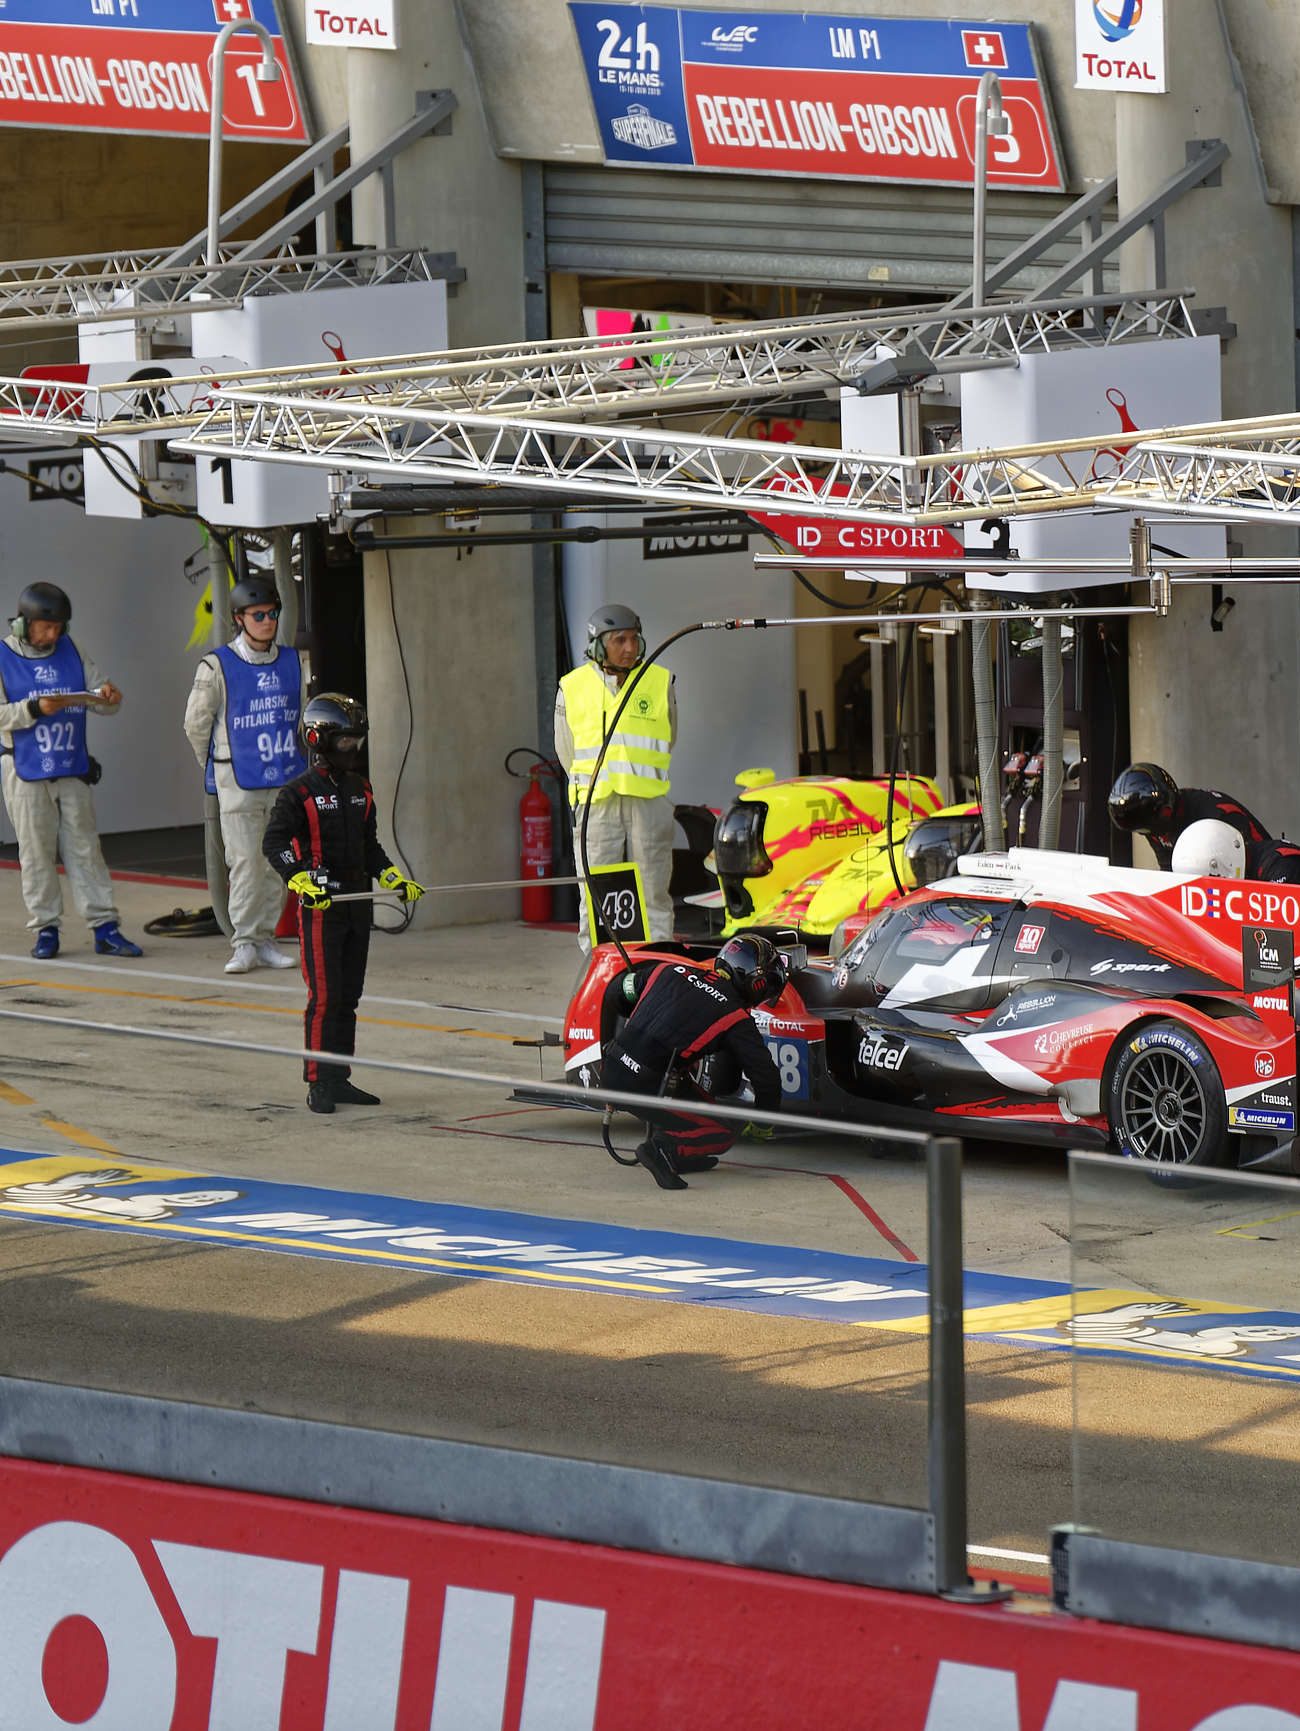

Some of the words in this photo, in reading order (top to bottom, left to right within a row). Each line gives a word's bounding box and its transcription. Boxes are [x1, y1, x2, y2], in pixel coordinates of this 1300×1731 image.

[314, 9, 388, 37] TOTAL
[596, 19, 660, 72] 24h
[829, 27, 855, 58] LM
[860, 30, 881, 60] P1
[599, 69, 617, 84] LE
[618, 71, 660, 87] MANS
[1082, 53, 1156, 81] TOTAL
[235, 64, 266, 117] 1
[696, 94, 958, 160] REBELLION-GIBSON
[860, 526, 944, 548] SPORT
[35, 722, 75, 754] 922
[598, 888, 637, 931] 48
[1021, 927, 1041, 942] 10
[1259, 948, 1279, 962] ICM
[693, 978, 728, 1004] SPORT
[1254, 996, 1289, 1012] MOTUL
[568, 1027, 594, 1041] MOTUL
[771, 1017, 806, 1033] TOTAL
[857, 1037, 911, 1072] telcel
[1148, 1033, 1199, 1062] MICHELIN
[1260, 1092, 1292, 1107] traust.
[1247, 1114, 1286, 1126] MICHELIN
[196, 1212, 931, 1303] MICHELIN
